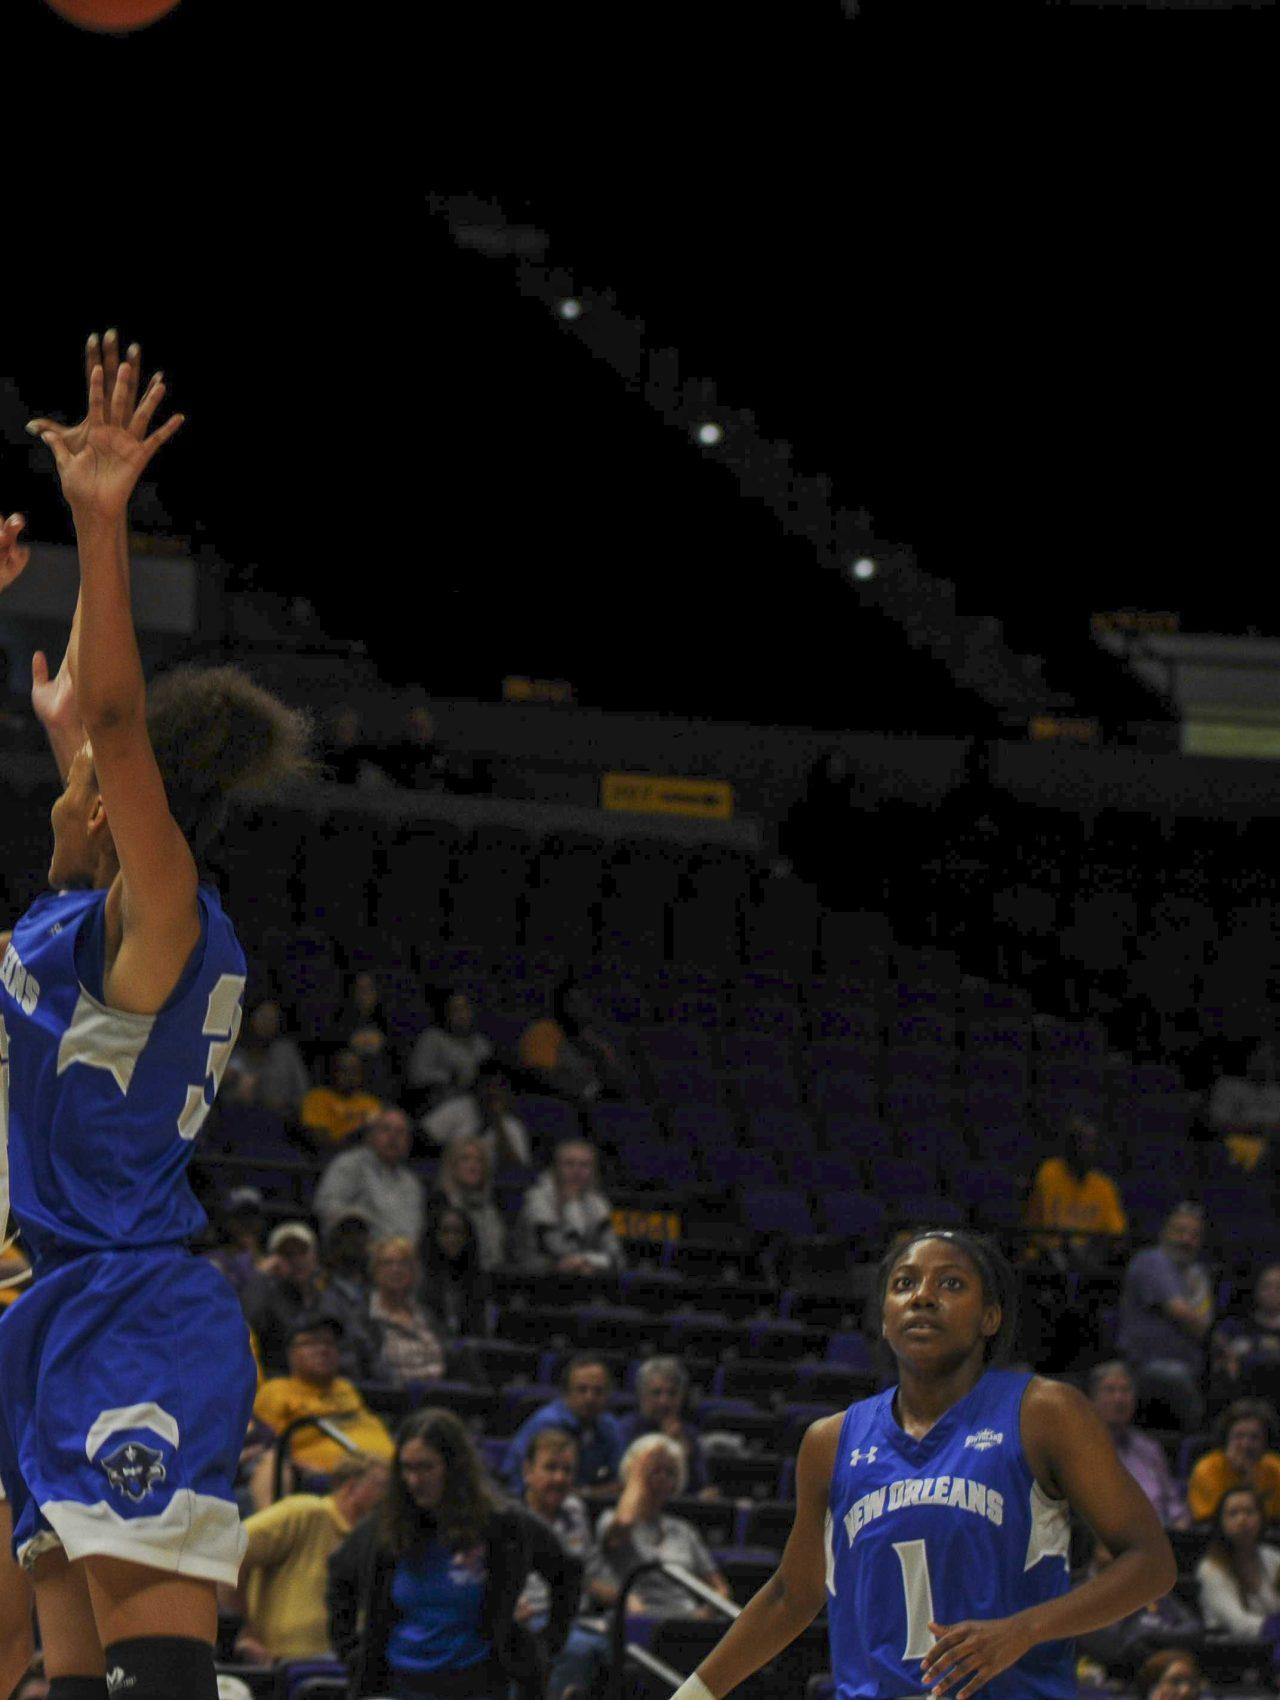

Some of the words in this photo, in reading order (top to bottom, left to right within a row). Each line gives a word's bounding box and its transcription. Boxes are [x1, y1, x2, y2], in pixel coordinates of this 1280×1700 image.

[843, 1486, 888, 1548] NEW
[887, 1475, 1004, 1527] ORLEANS
[891, 1538, 937, 1661] 1
